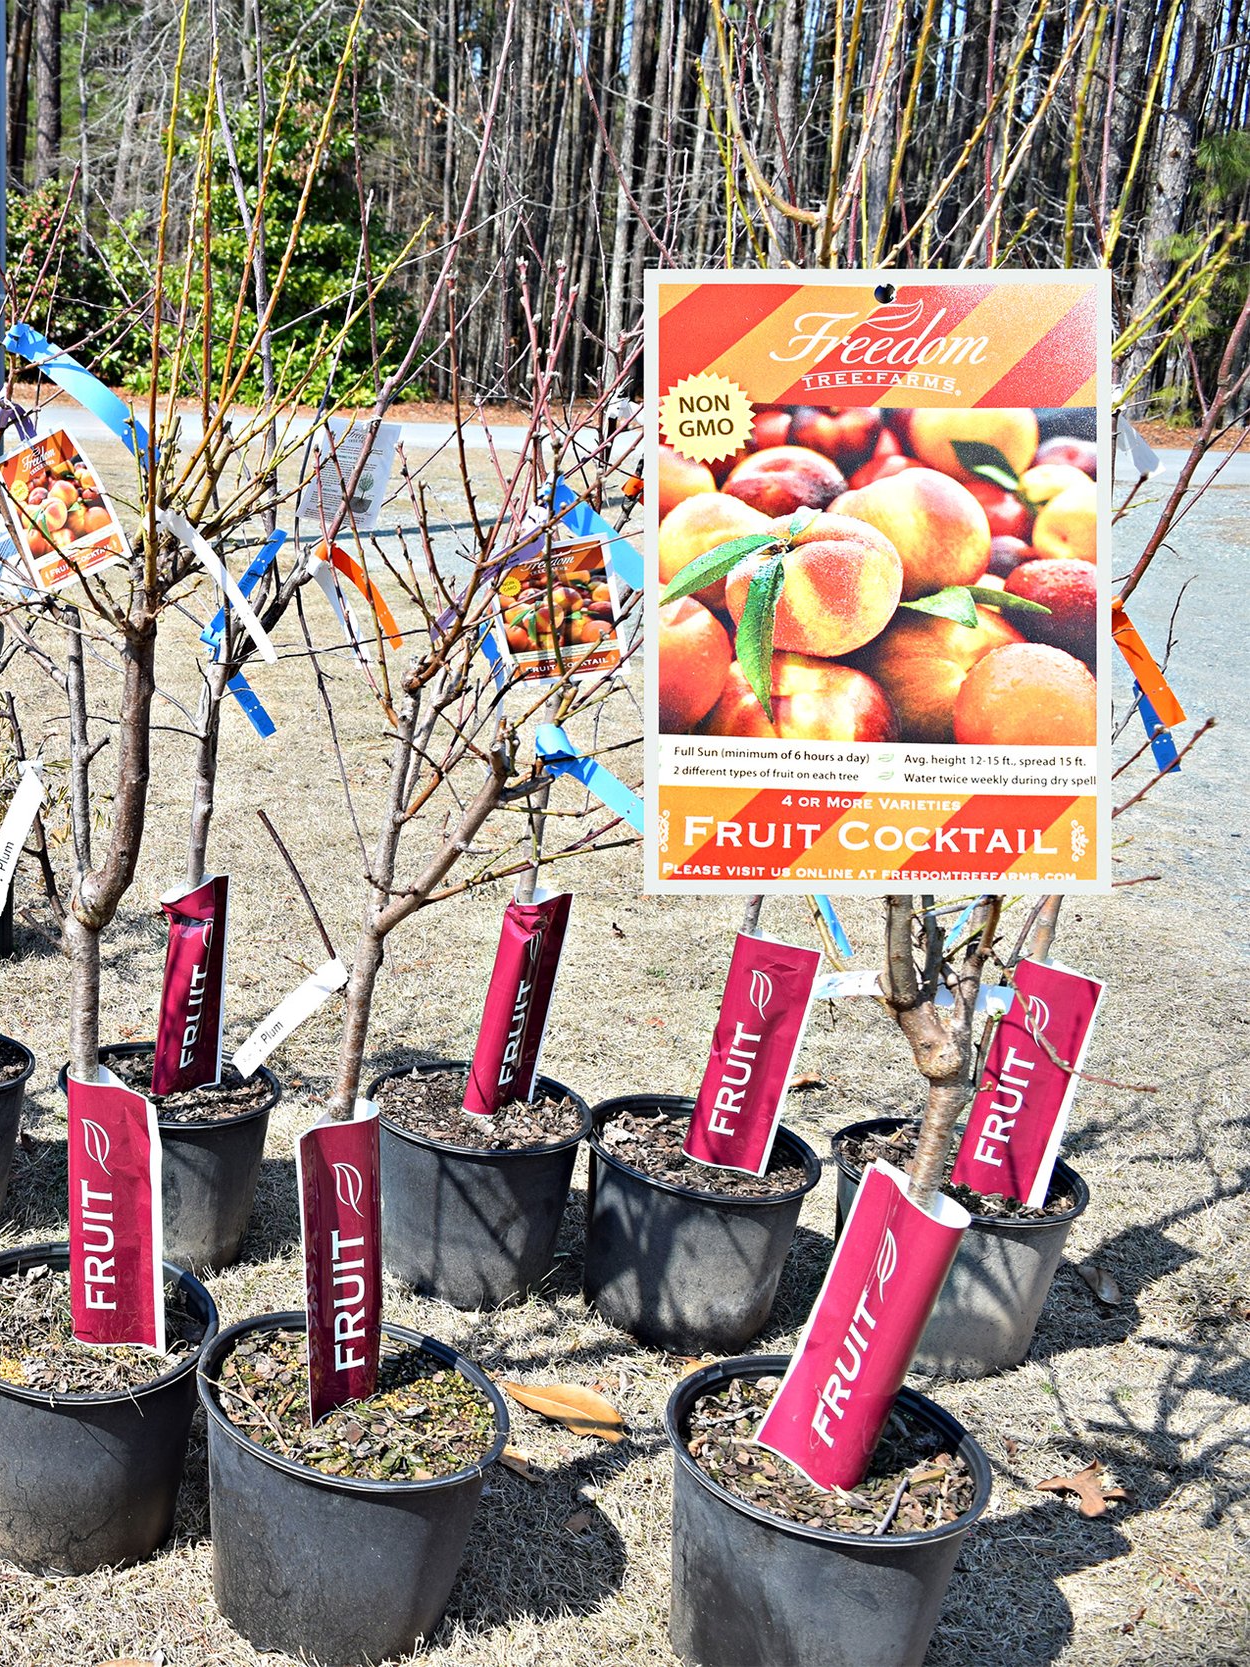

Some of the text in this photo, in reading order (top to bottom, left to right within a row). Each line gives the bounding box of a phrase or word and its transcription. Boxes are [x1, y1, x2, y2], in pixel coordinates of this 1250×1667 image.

[769, 306, 990, 365] Freedom
[679, 394, 730, 413] NON
[679, 417, 734, 438] GMO
[674, 746, 695, 756] Full
[697, 746, 718, 757] Sun
[721, 748, 778, 760] (minimum
[781, 749, 792, 760] of
[794, 750, 801, 760] 6
[804, 751, 835, 762] hours
[846, 753, 870, 765] day)
[904, 755, 1086, 769] Avg. height 12-15 ft., spread 15 ft.
[673, 766, 859, 782] 2 different types of fruit on each tree
[903, 773, 936, 784] Water
[939, 775, 968, 785] twice
[971, 775, 1009, 787] weekly
[1011, 775, 1048, 788] during
[1050, 776, 1068, 788] dry
[781, 795, 962, 812] 4 OR MORE VARIETIES
[683, 815, 1058, 855] FRUIT COCKTAIL
[662, 861, 1078, 880] PLEASE VISIT US ONLINE AT FREEDOMTREEFARMS.COM
[179, 963, 209, 1070] FRUIT
[497, 978, 533, 1087] FRUIT
[260, 1021, 284, 1045] Plum
[707, 1022, 762, 1137] FRUIT
[973, 1047, 1035, 1168] FRUIT
[84, 1179, 117, 1311] FRUIT
[330, 1228, 367, 1373] FRUIT
[811, 1290, 880, 1450] FRUIT
